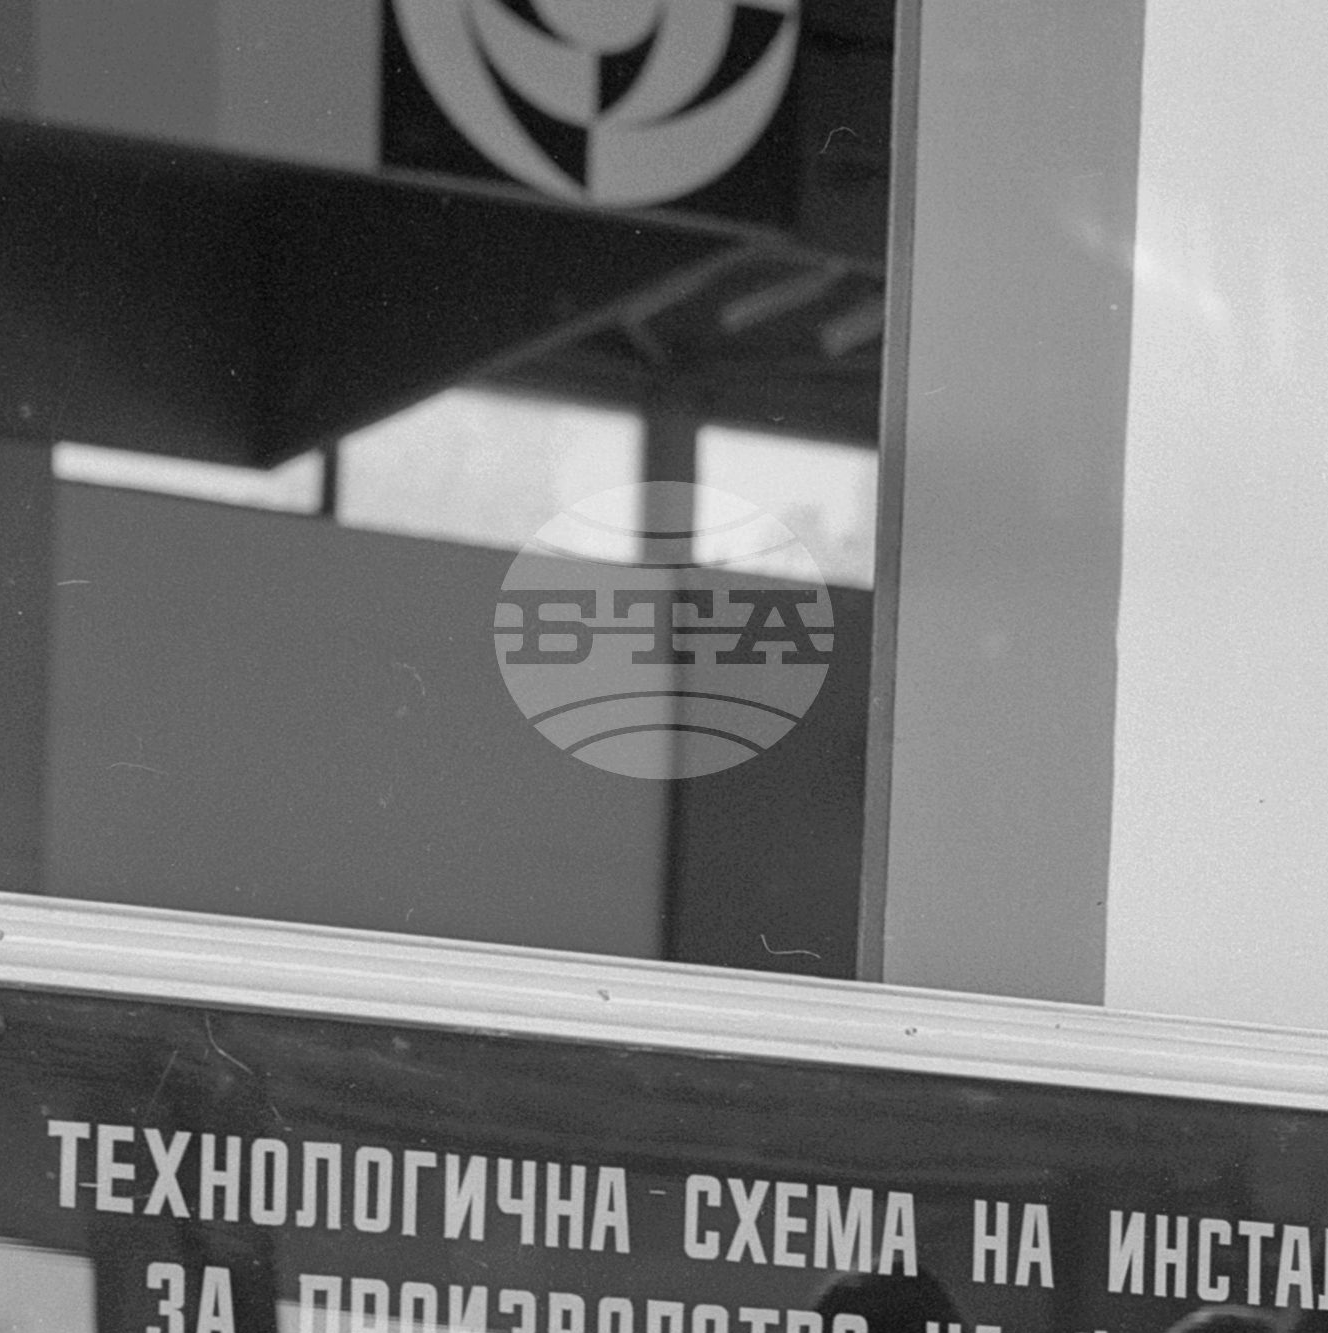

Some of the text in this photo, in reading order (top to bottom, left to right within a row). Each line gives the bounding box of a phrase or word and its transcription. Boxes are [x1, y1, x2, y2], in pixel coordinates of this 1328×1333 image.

[47, 1119, 631, 1254] ТЕХНОЛОГИЧНА
[684, 1174, 919, 1277] СХЕМА
[972, 1199, 1055, 1289] НА
